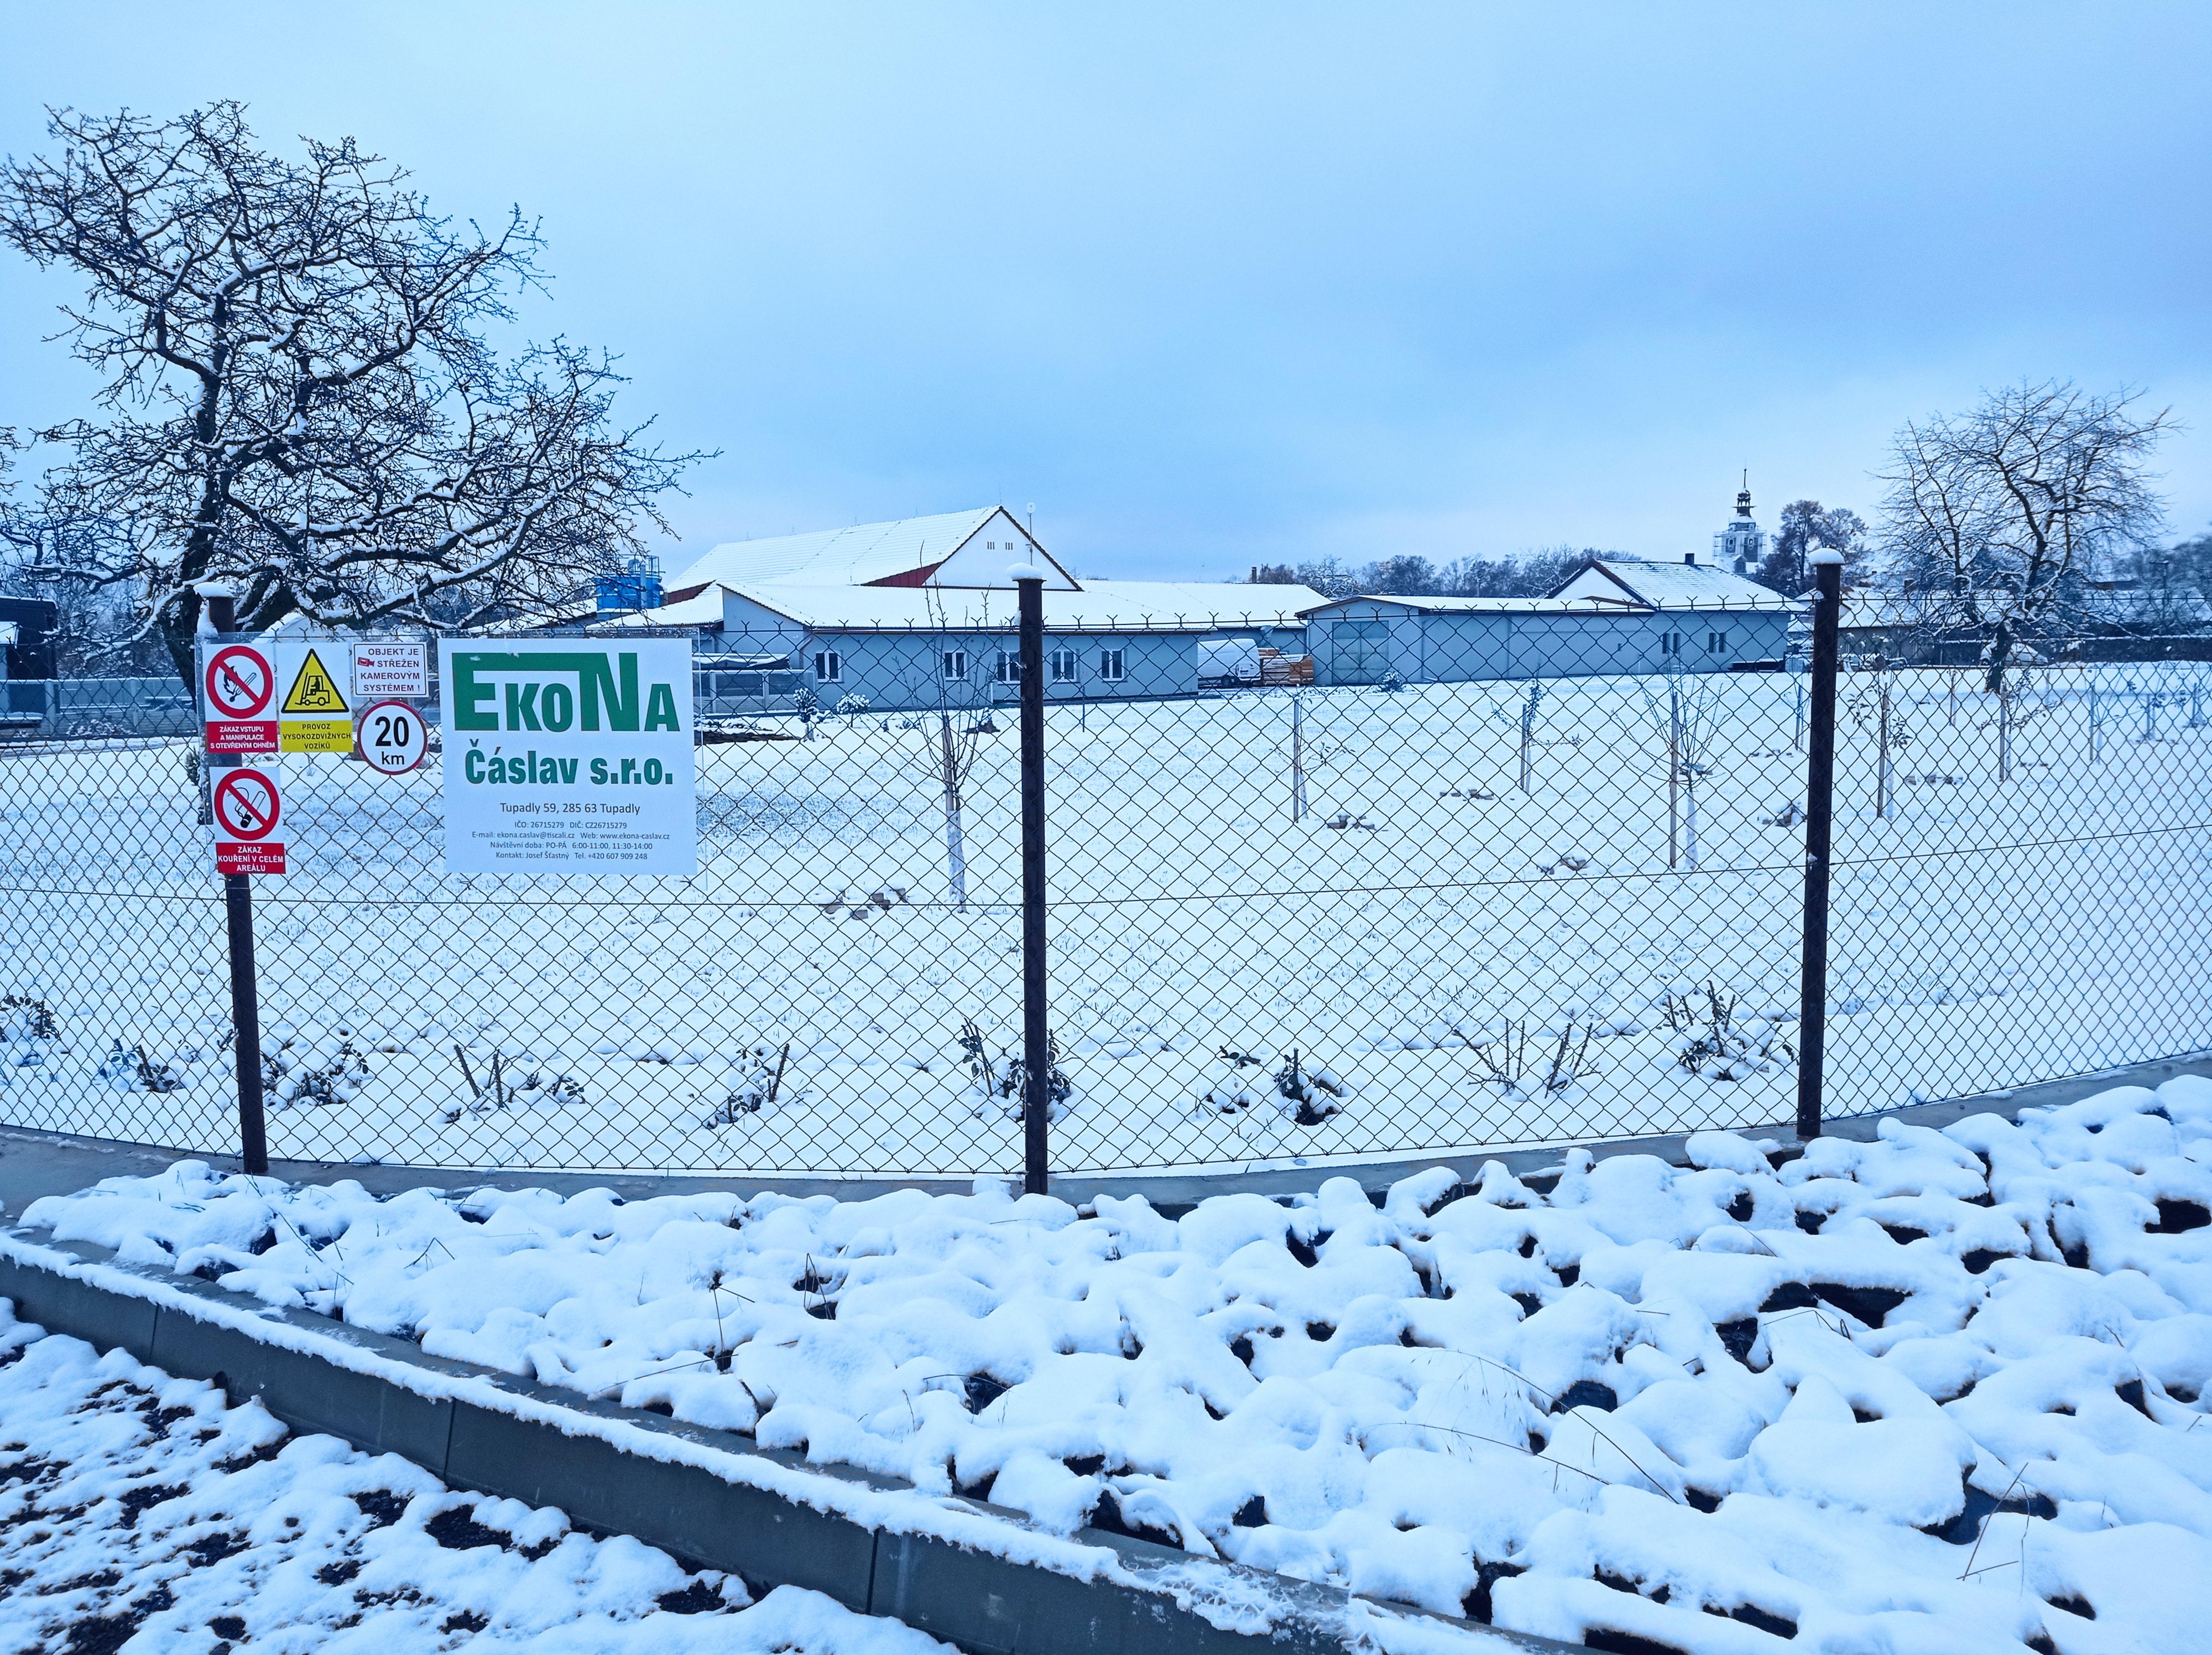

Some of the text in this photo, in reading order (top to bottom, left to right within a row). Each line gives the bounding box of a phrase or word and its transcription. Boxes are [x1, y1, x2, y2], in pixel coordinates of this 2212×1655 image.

[377, 659, 419, 667] STŘEŽEN
[361, 671, 420, 679] KAMEROVÝM
[363, 683, 414, 691] SYSTÉMEM
[375, 716, 409, 747] 20
[381, 751, 404, 764] km
[465, 738, 673, 785] Čáslav s.r.o.
[500, 803, 640, 815] Tupadly 59, 285 63 Tupadly
[238, 845, 262, 853] ZÁKAZ
[218, 854, 250, 862] KOUŘENÍ
[545, 851, 570, 860] Šťastný
